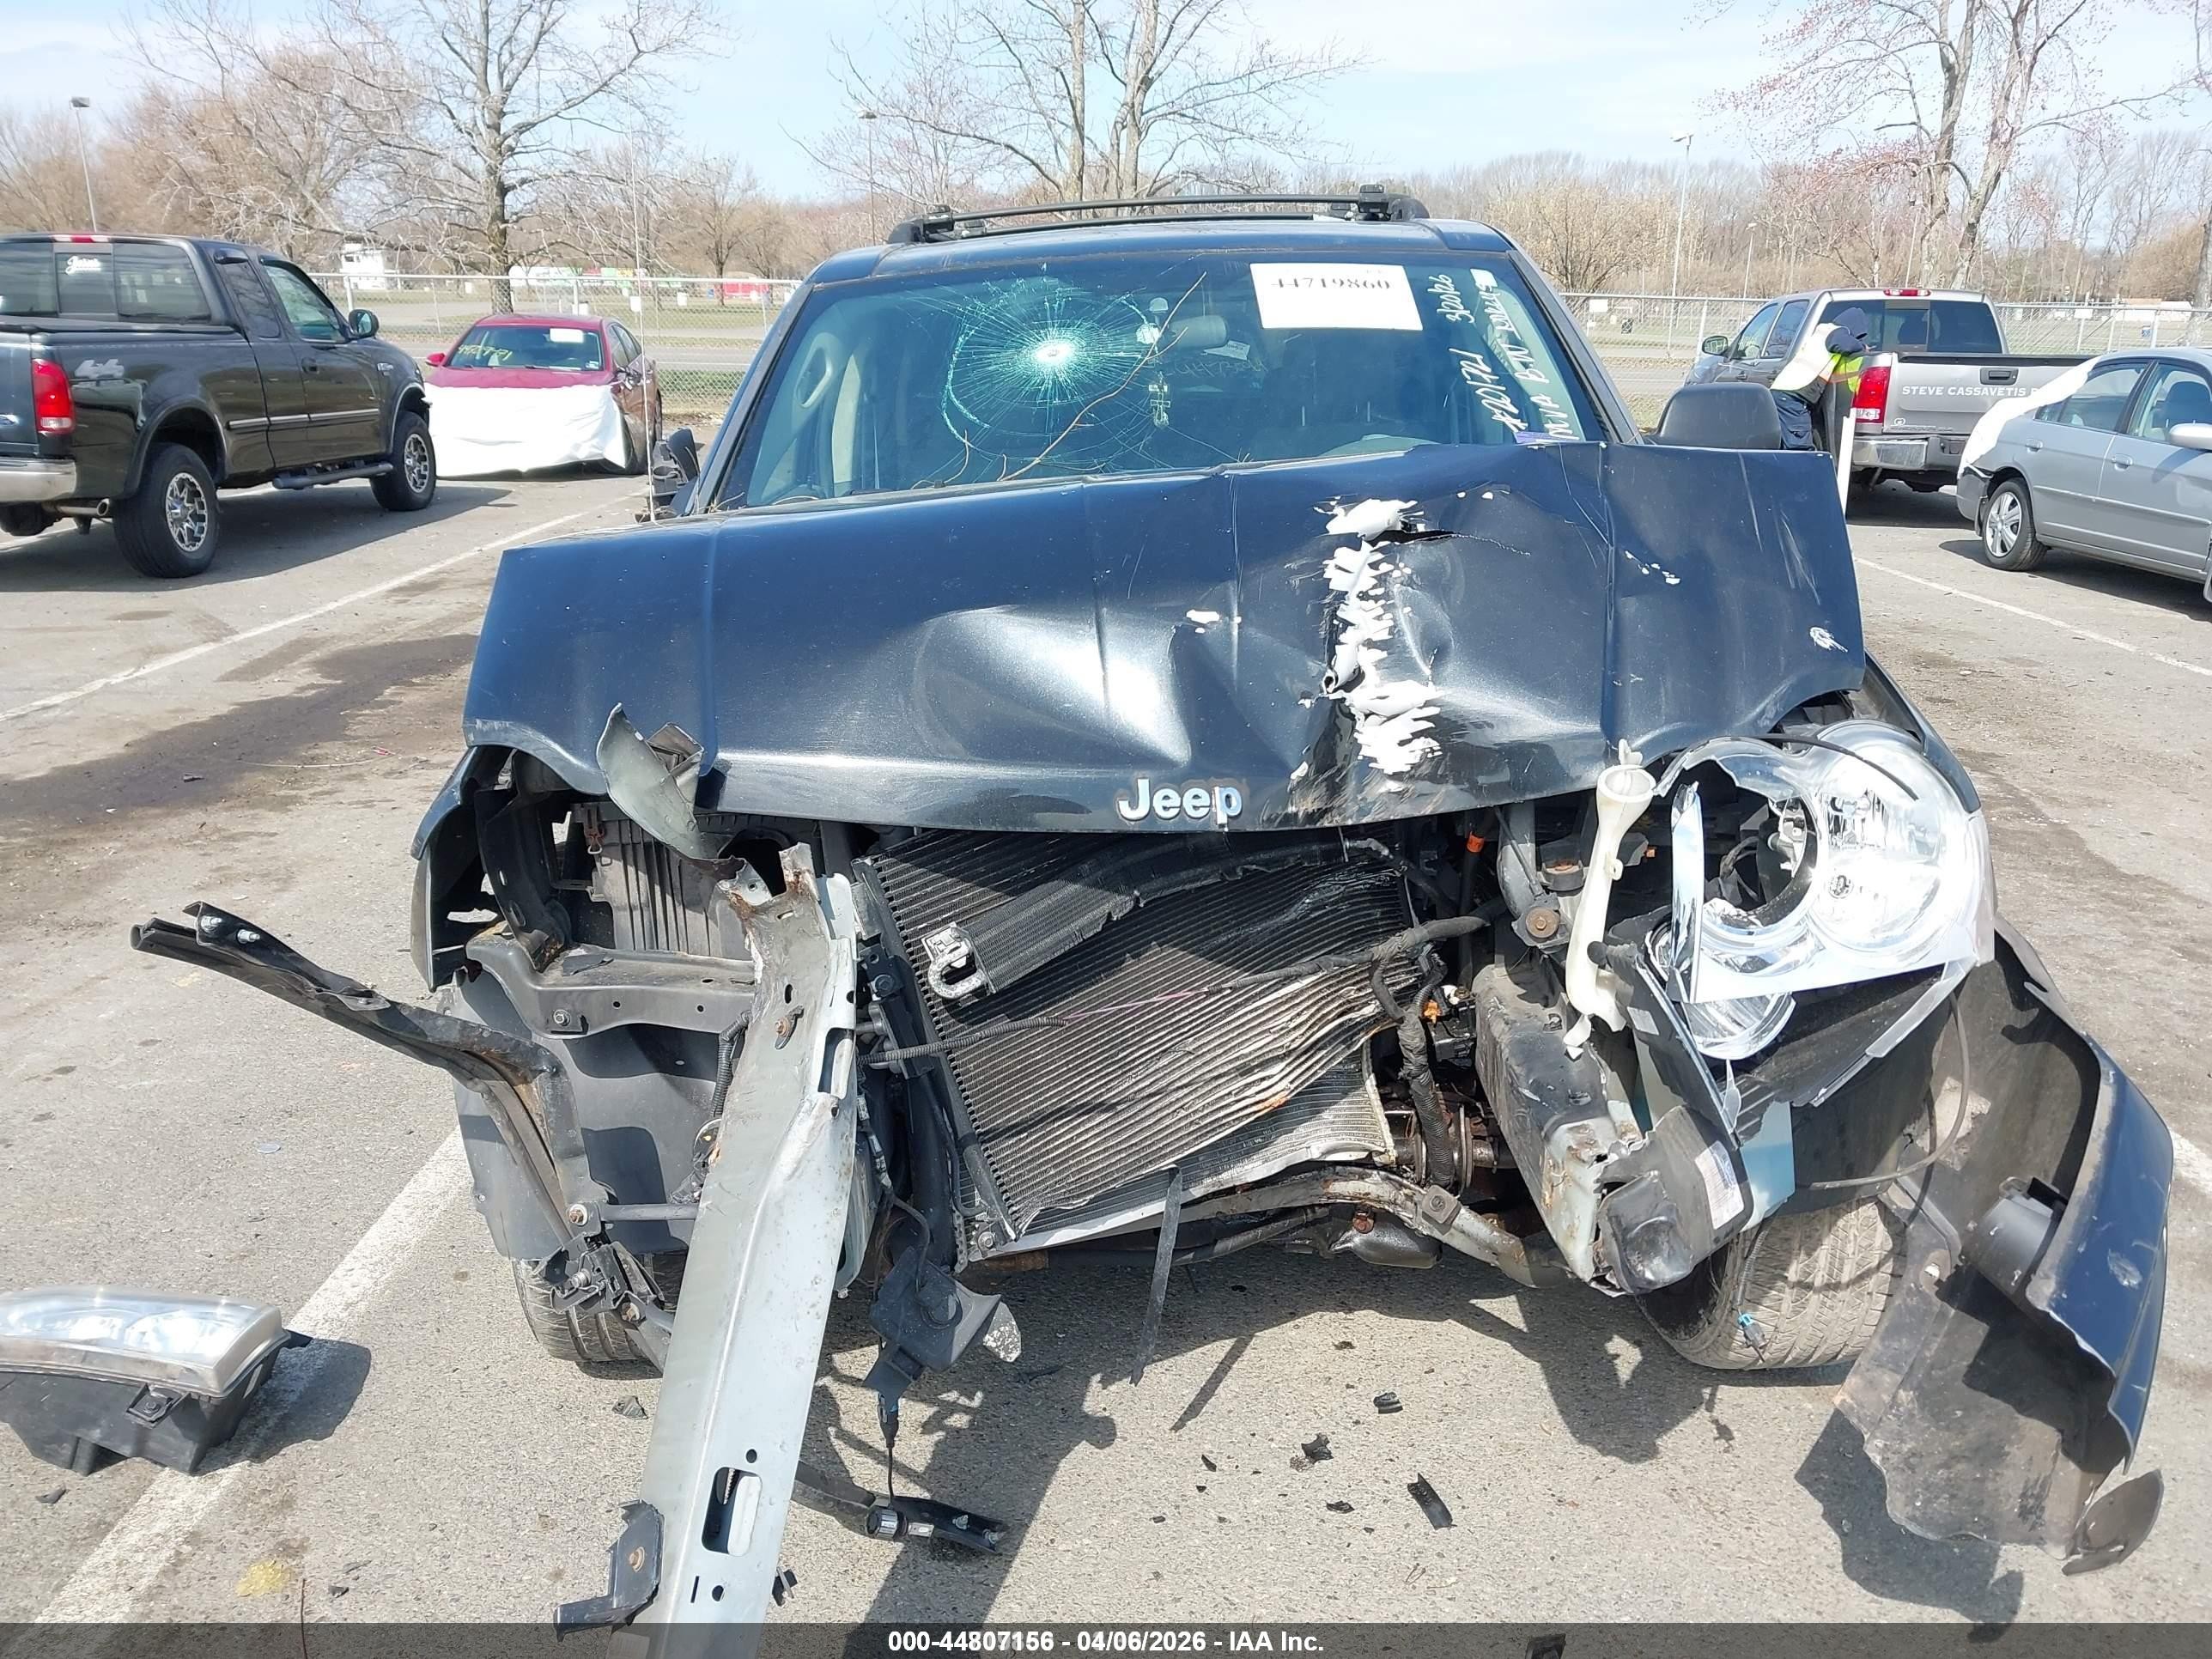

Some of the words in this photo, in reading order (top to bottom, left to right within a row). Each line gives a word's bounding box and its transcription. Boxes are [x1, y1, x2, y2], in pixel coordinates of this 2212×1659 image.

[1902, 386, 1944, 396] STEVE
[1947, 386, 2027, 397] CASSAVETIS
[1118, 778, 1243, 825] Jeep
